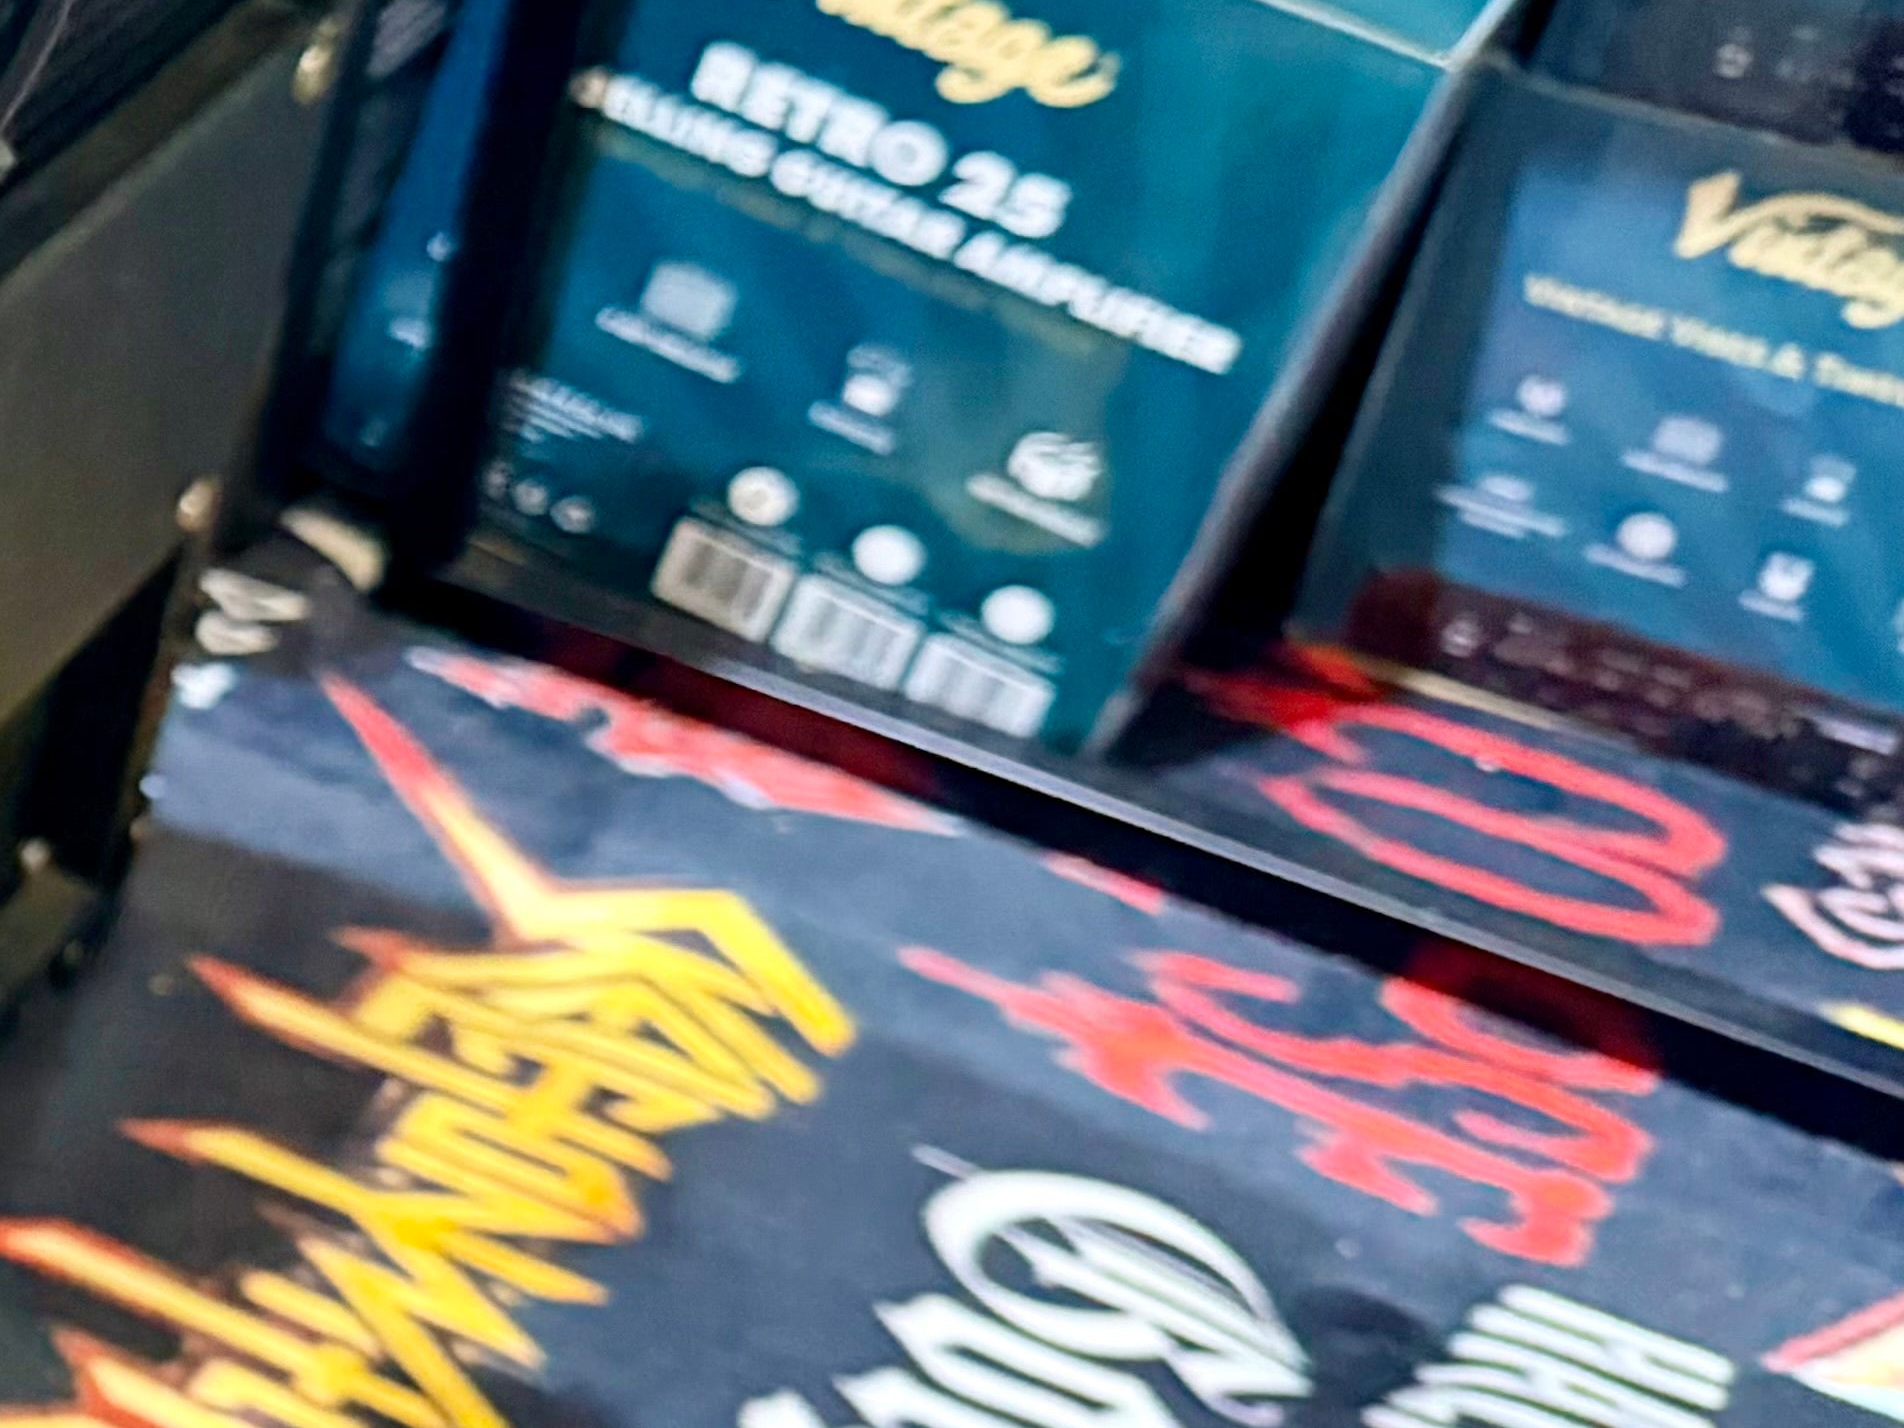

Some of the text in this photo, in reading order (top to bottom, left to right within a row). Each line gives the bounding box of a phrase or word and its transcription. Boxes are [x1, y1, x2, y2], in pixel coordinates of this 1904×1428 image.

[692, 41, 1073, 239] RETRO 25
[769, 150, 968, 259] GUITAR
[952, 230, 1243, 375] AMPLIFIER
